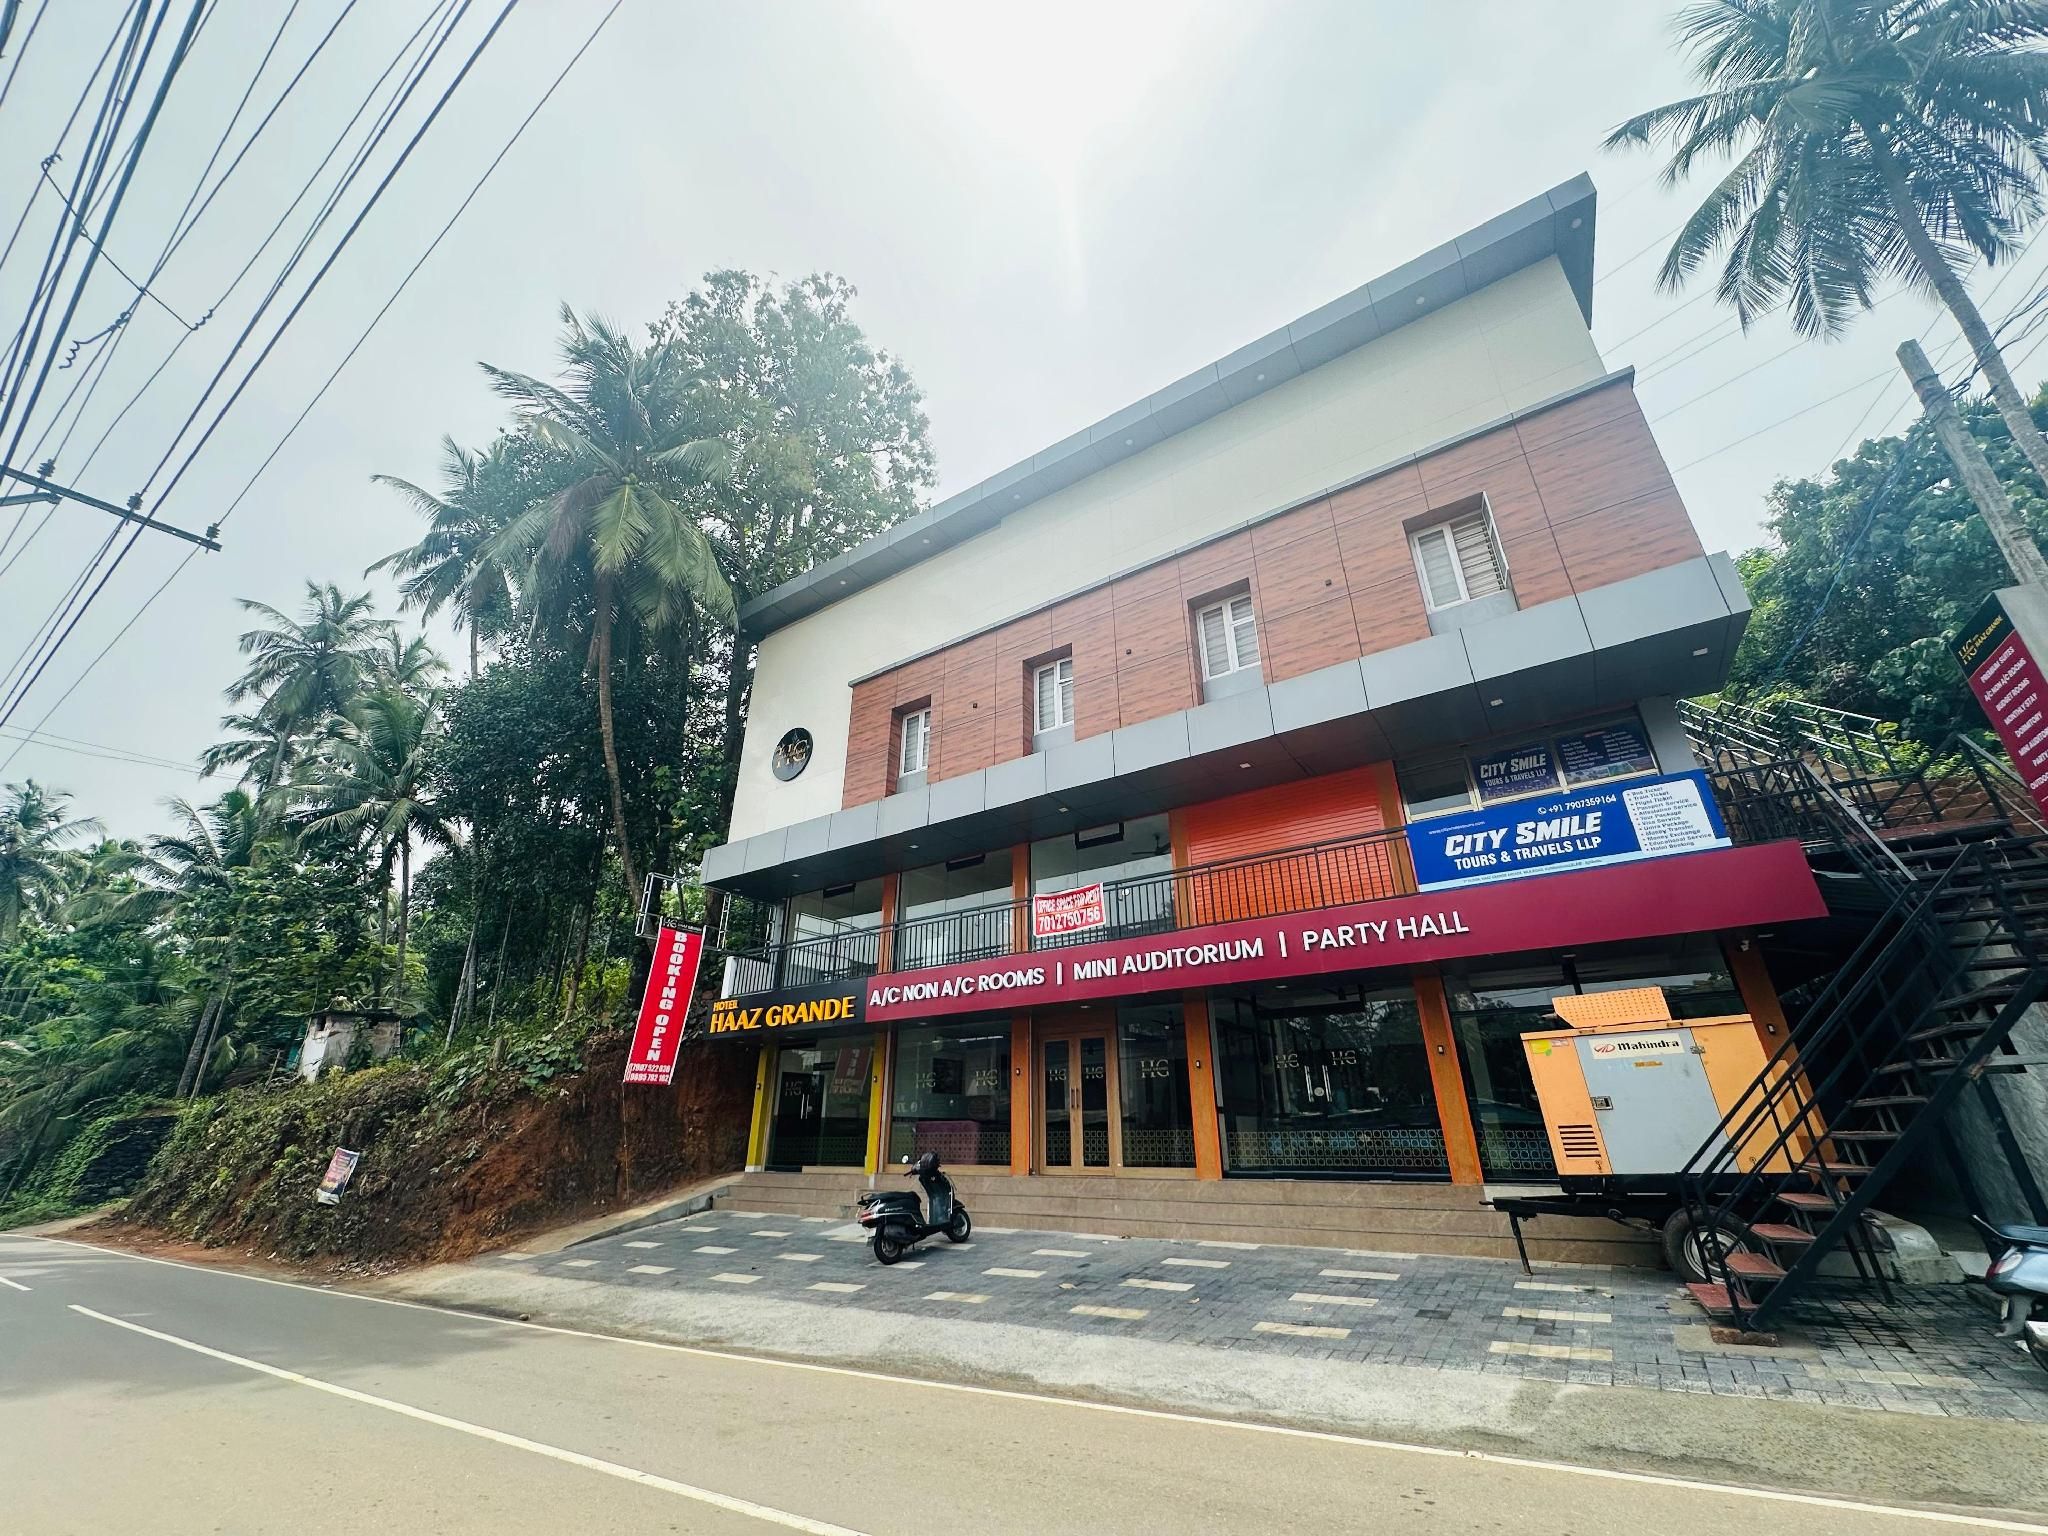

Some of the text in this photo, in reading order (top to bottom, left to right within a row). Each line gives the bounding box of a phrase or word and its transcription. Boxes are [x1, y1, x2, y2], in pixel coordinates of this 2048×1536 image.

[1999, 646, 2015, 664] SUITES
[2008, 658, 2027, 677] ROOMS
[2011, 678, 2030, 696] ROOMS
[2004, 692, 2038, 725] MONTHLY STAY
[2014, 711, 2042, 738] DORMITORY
[1480, 754, 1546, 778] CITY SMILE
[1484, 778, 1503, 787] TOURS
[1510, 772, 1535, 783] TRAVELS
[1536, 768, 1547, 777] LLP
[1548, 794, 1617, 814] +91 7907359164
[1445, 812, 1602, 857] CITY SMILE
[1454, 837, 1602, 871] TOURS & TRAVELS LLP
[1037, 887, 1099, 913] OFFICE SPACE FOR RENT
[1038, 906, 1100, 932] 7012750756
[1302, 911, 1470, 952] PARTY HALL
[1072, 938, 1264, 980] MINI AUDITORIUM
[646, 931, 688, 1061] BOOKING OPEN
[870, 967, 1045, 1007] A/C NON A/C ROOMS
[709, 996, 856, 1034] HAAZ GRANDE
[713, 1000, 739, 1012] HOTEL
[1617, 1040, 1680, 1051] Mahindra
[914, 1071, 936, 1089] HG
[975, 1069, 999, 1088] HG
[1141, 1059, 1169, 1078] HG
